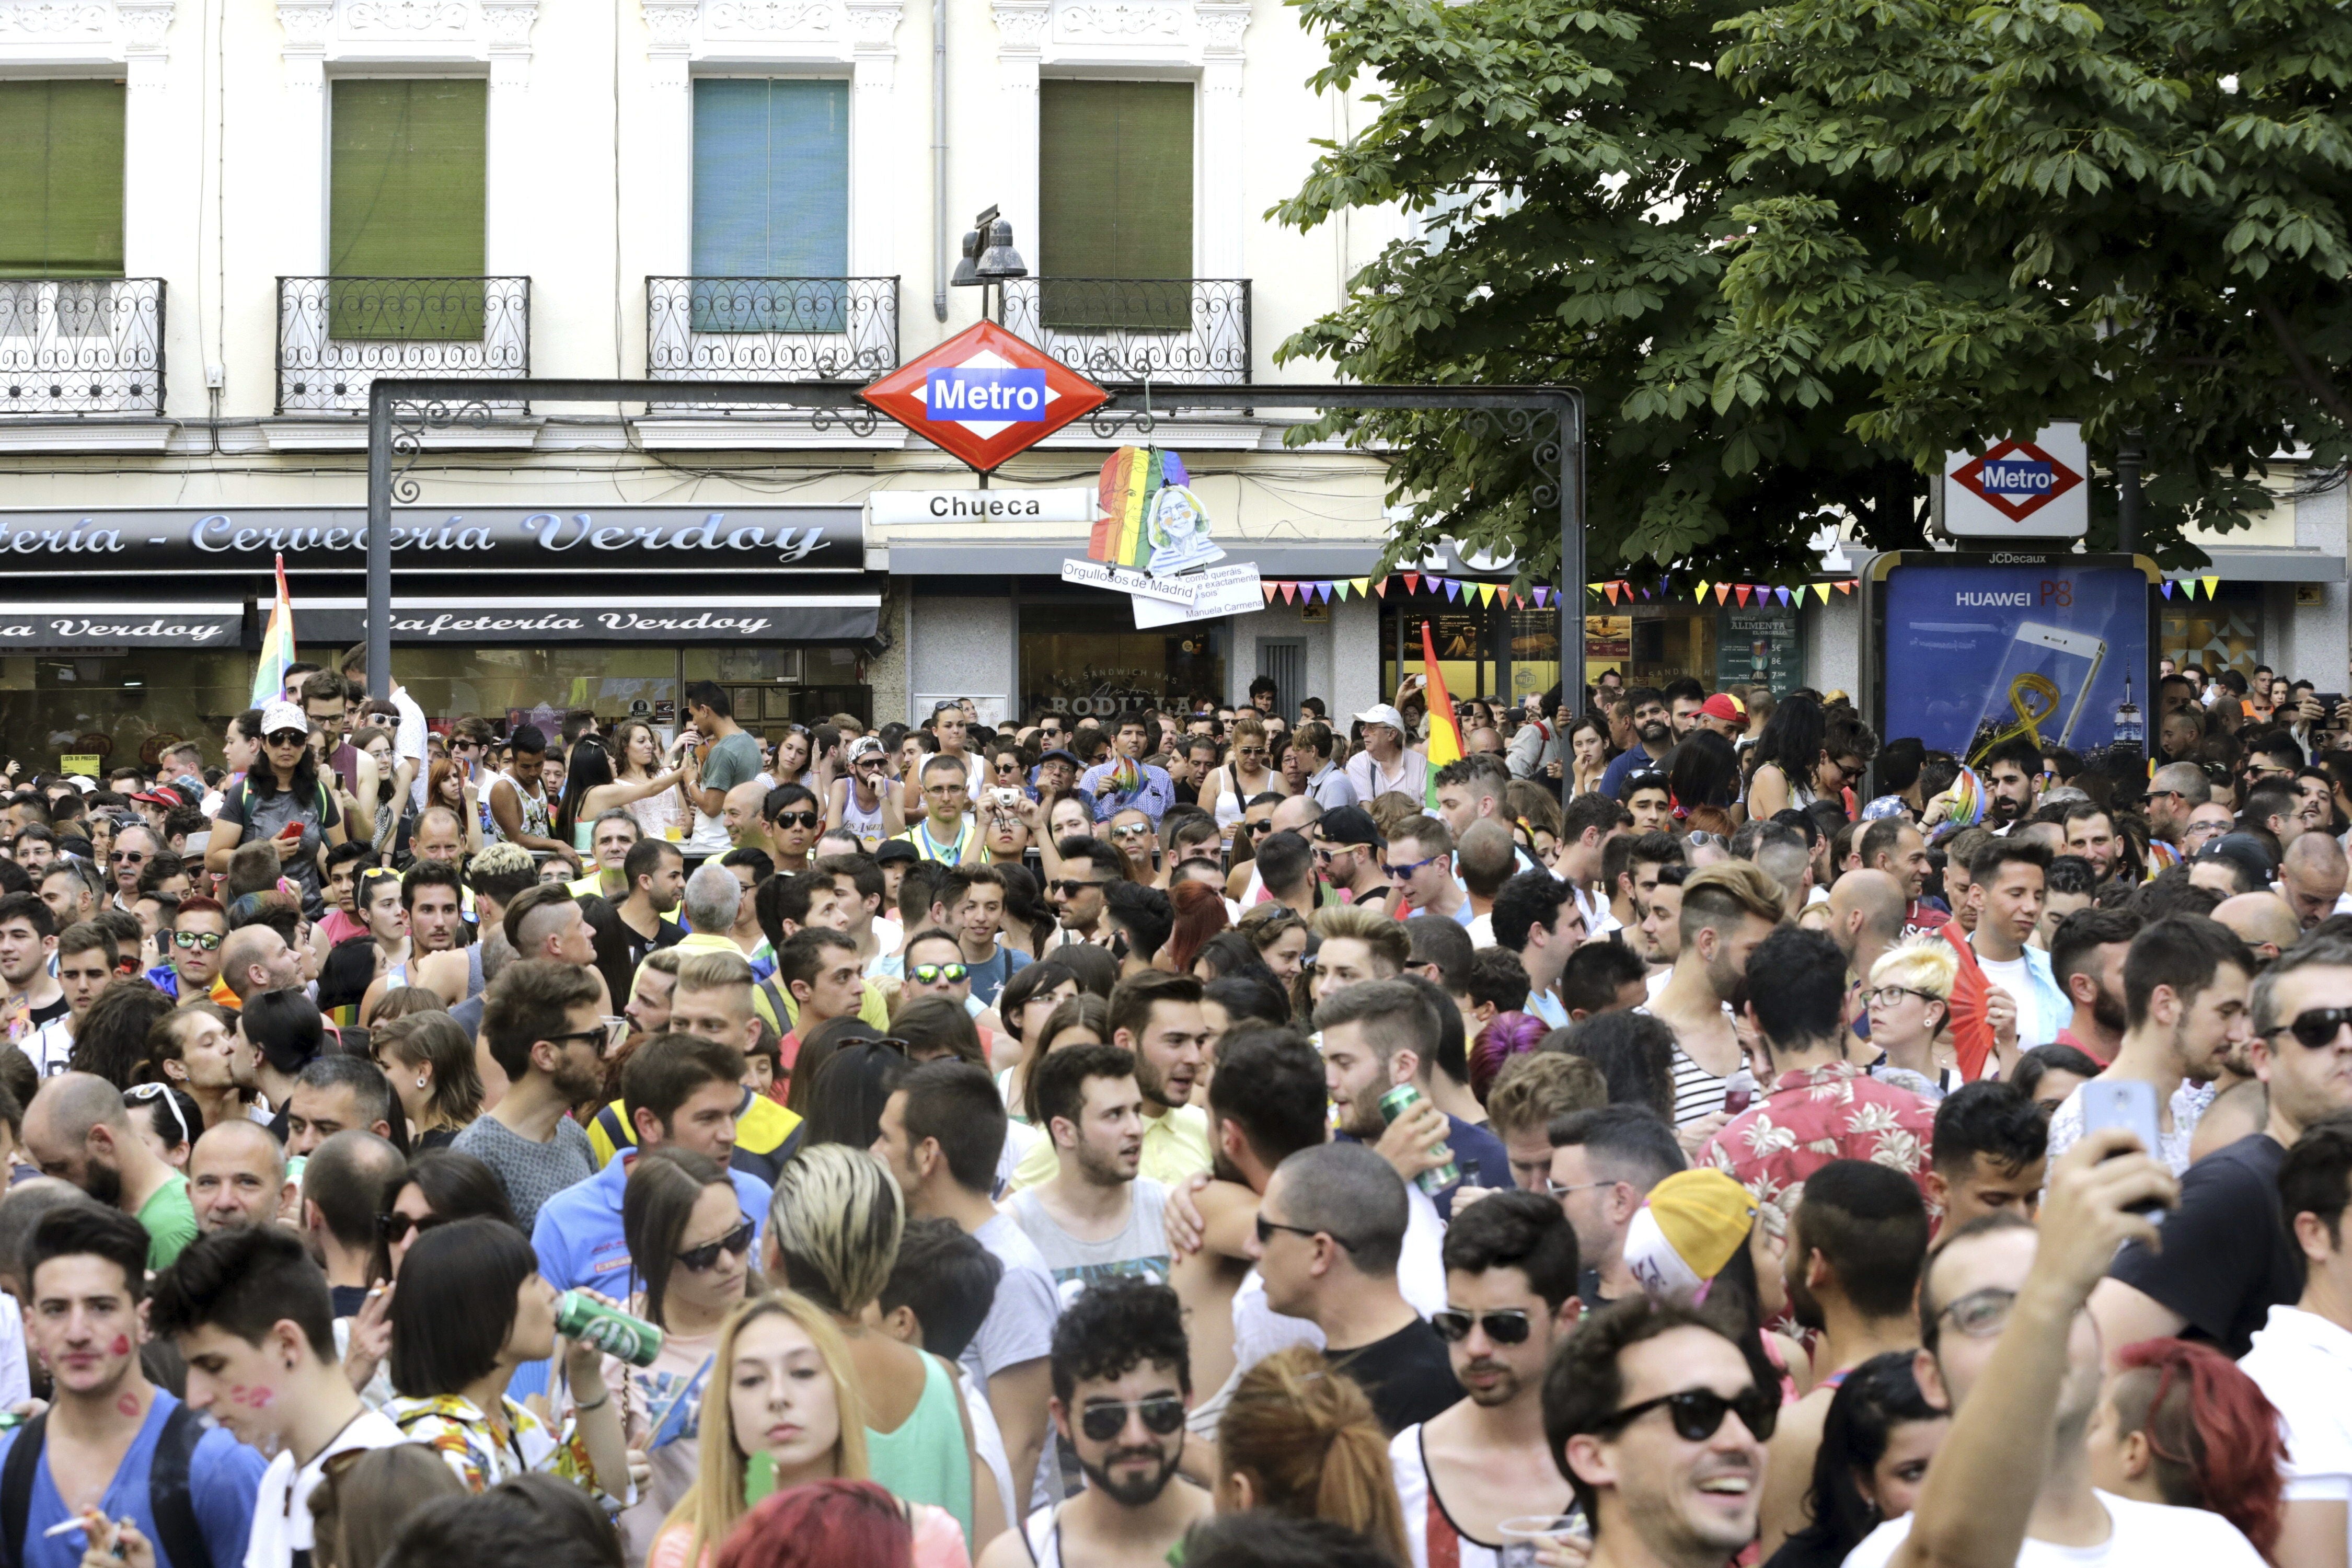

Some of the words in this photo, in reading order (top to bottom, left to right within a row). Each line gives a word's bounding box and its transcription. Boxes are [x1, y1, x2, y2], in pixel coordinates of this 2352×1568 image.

[935, 379, 1039, 410] Metro
[1985, 467, 2049, 489] Metro
[930, 497, 1040, 516] Chueca
[524, 513, 831, 563] Verdoy
[1989, 554, 2046, 564] JCDecaux
[1064, 563, 1128, 586] Orgullosos
[1132, 574, 1146, 589] de
[1150, 578, 1193, 598] Madrid
[1205, 574, 1259, 588] exactamente
[1956, 593, 2031, 606] HUAWEI
[2040, 580, 2073, 607] P8
[1186, 607, 1222, 618] Manuela
[1225, 600, 1263, 612] Carmena
[51, 619, 223, 641] Verdoy
[363, 613, 583, 635] afetería
[597, 613, 771, 633] Verdoy
[1062, 676, 1076, 686] EL
[1082, 668, 1147, 679] SANDWICH
[1648, 668, 1710, 677] SANDWH
